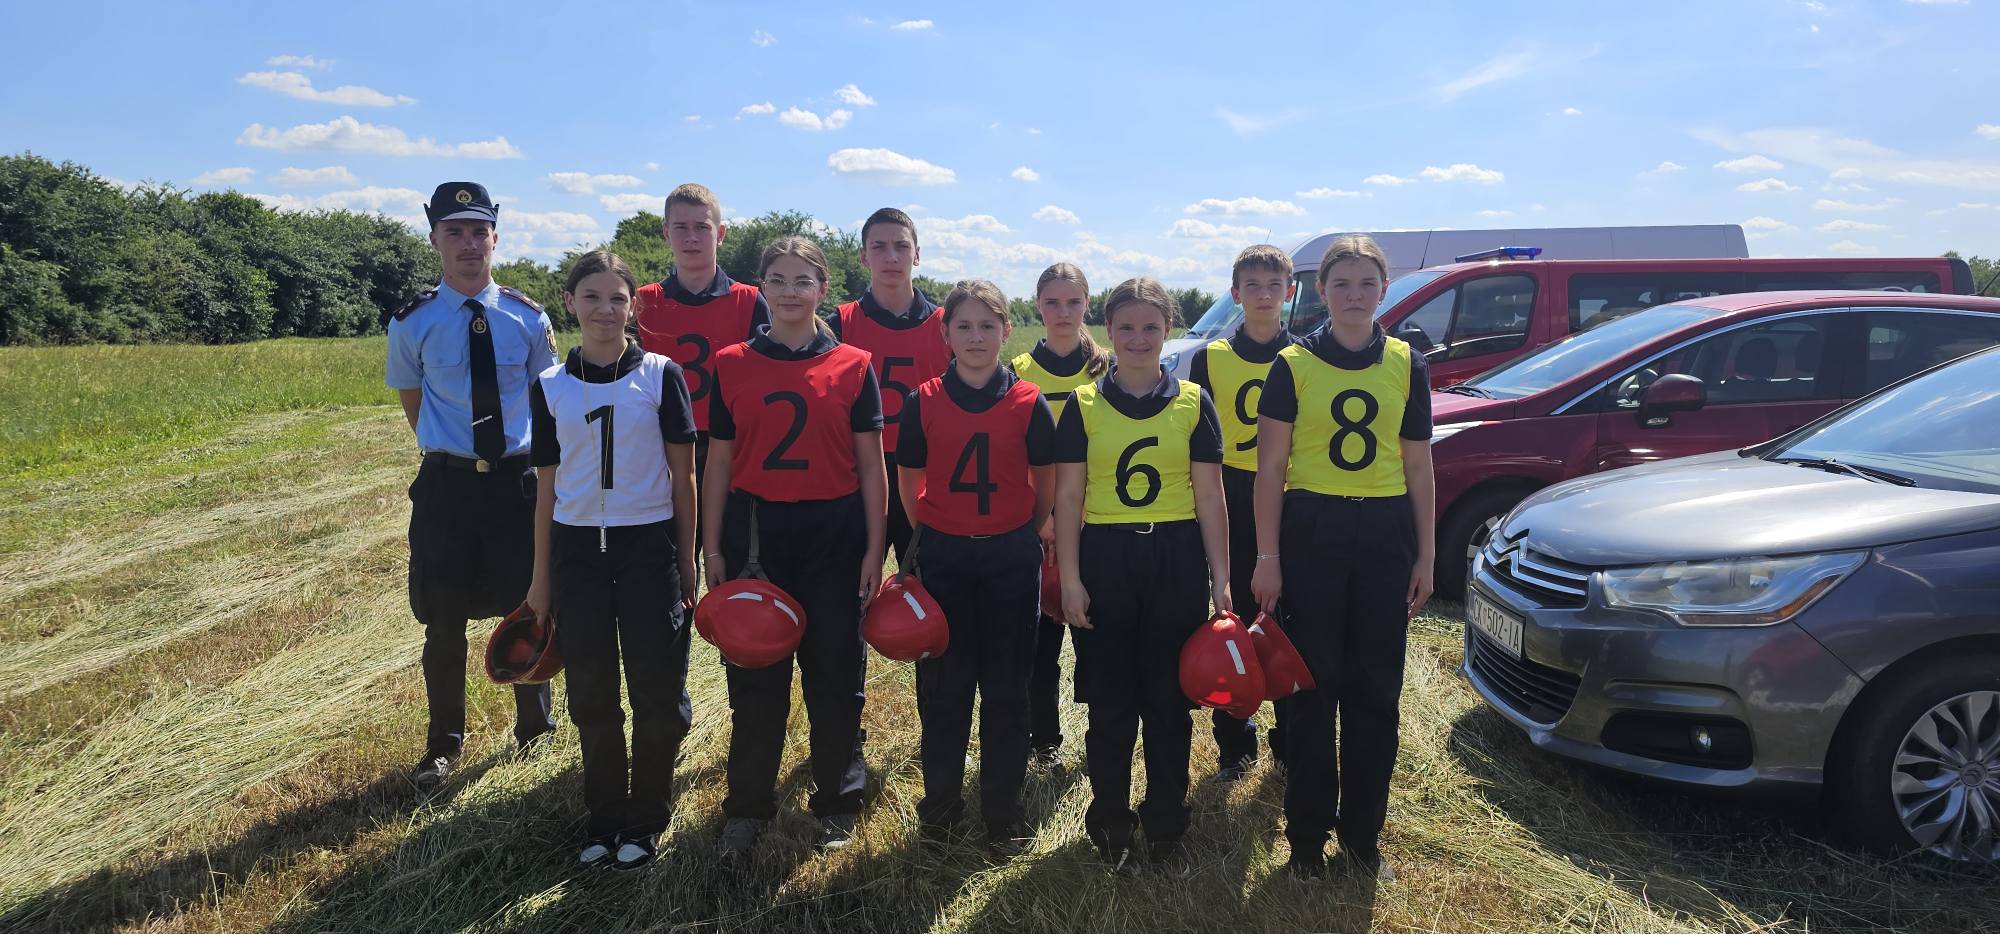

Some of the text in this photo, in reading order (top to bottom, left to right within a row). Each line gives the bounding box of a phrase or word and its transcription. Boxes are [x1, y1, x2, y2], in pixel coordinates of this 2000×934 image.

[677, 333, 711, 402] 3
[880, 356, 914, 424] 5
[584, 405, 614, 490] 1
[763, 392, 809, 471] 2
[1235, 379, 1264, 451] 9
[1329, 389, 1379, 471] 8
[949, 433, 998, 516] 4
[1115, 436, 1162, 507] 6
